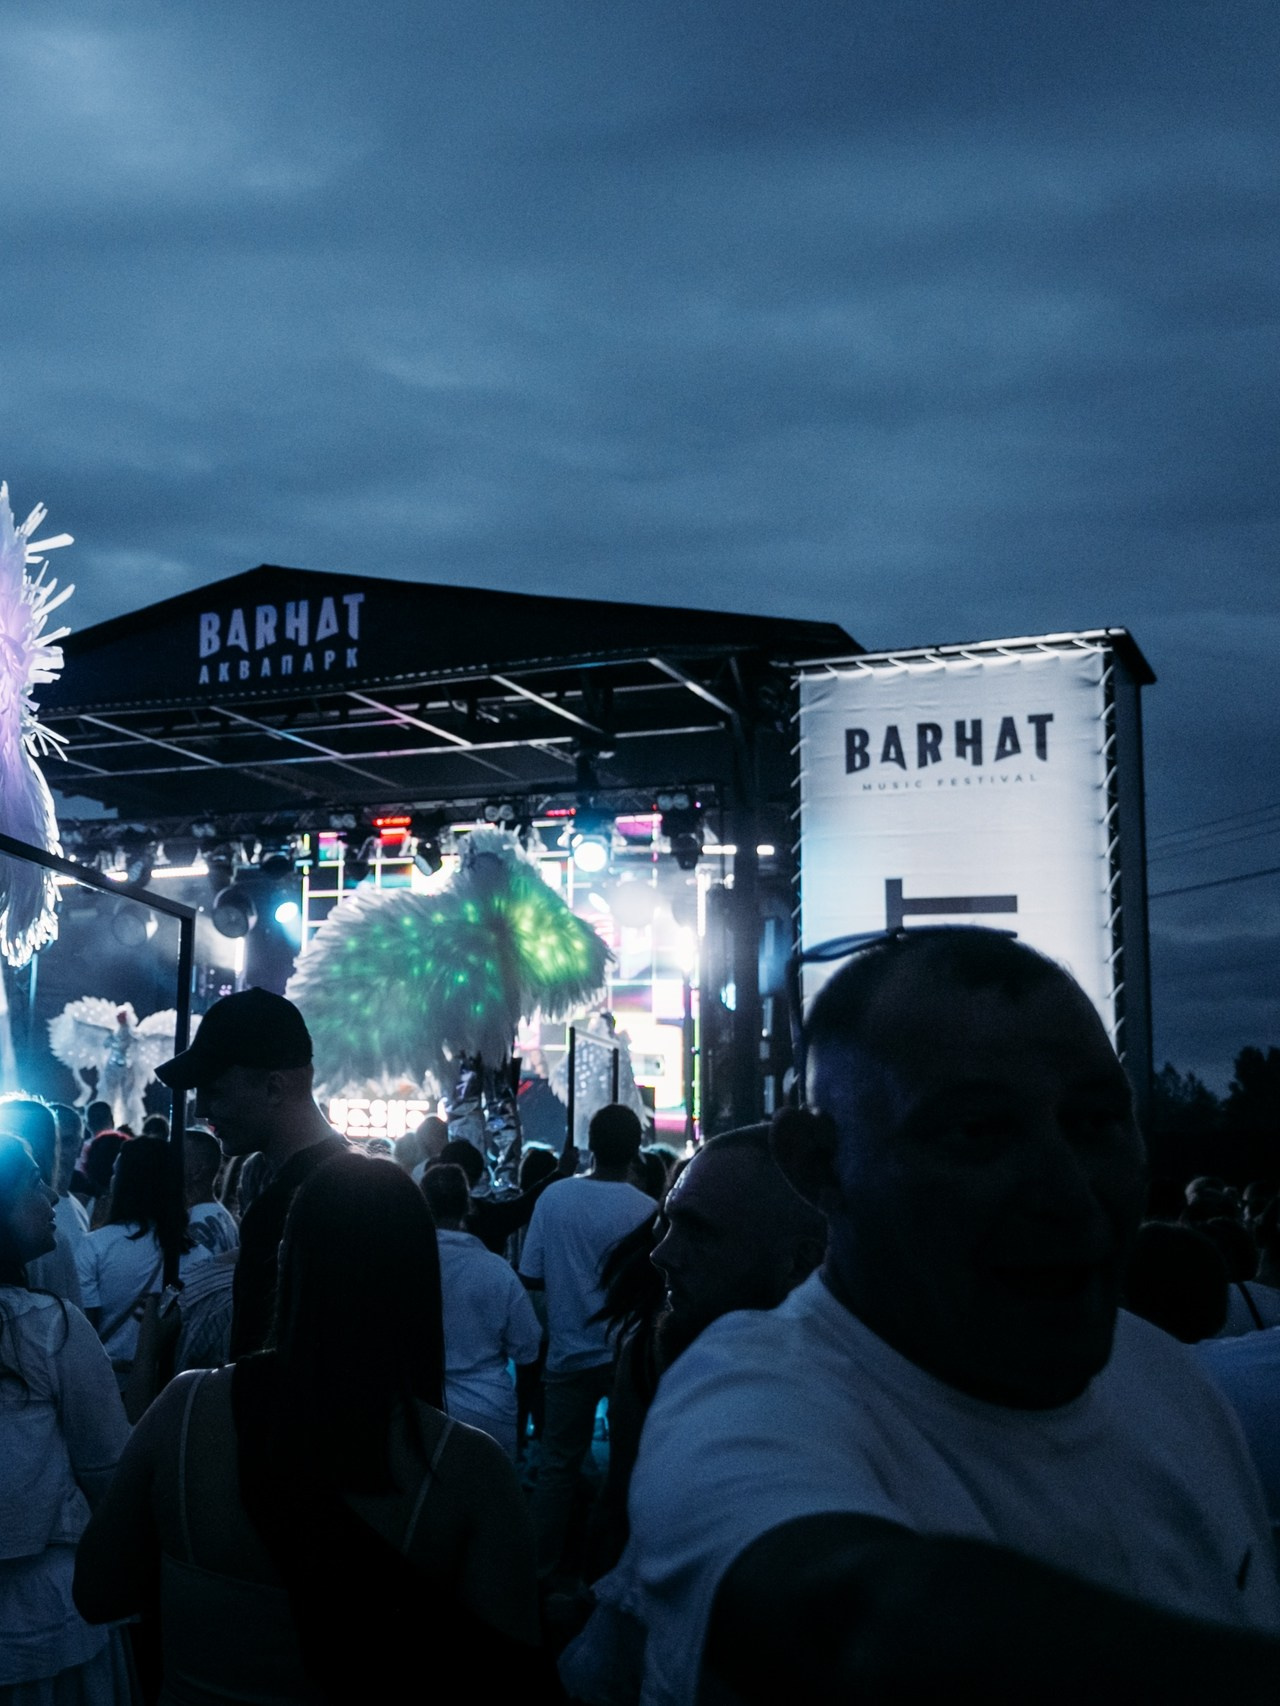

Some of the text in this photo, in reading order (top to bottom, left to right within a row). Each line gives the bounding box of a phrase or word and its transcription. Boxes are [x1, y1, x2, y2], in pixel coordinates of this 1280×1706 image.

[199, 593, 365, 658] BARHAT
[199, 647, 358, 684] АКВАПАРК
[845, 713, 1054, 775] BARHAT
[862, 774, 1037, 791] MUSIC FESTIVAL
